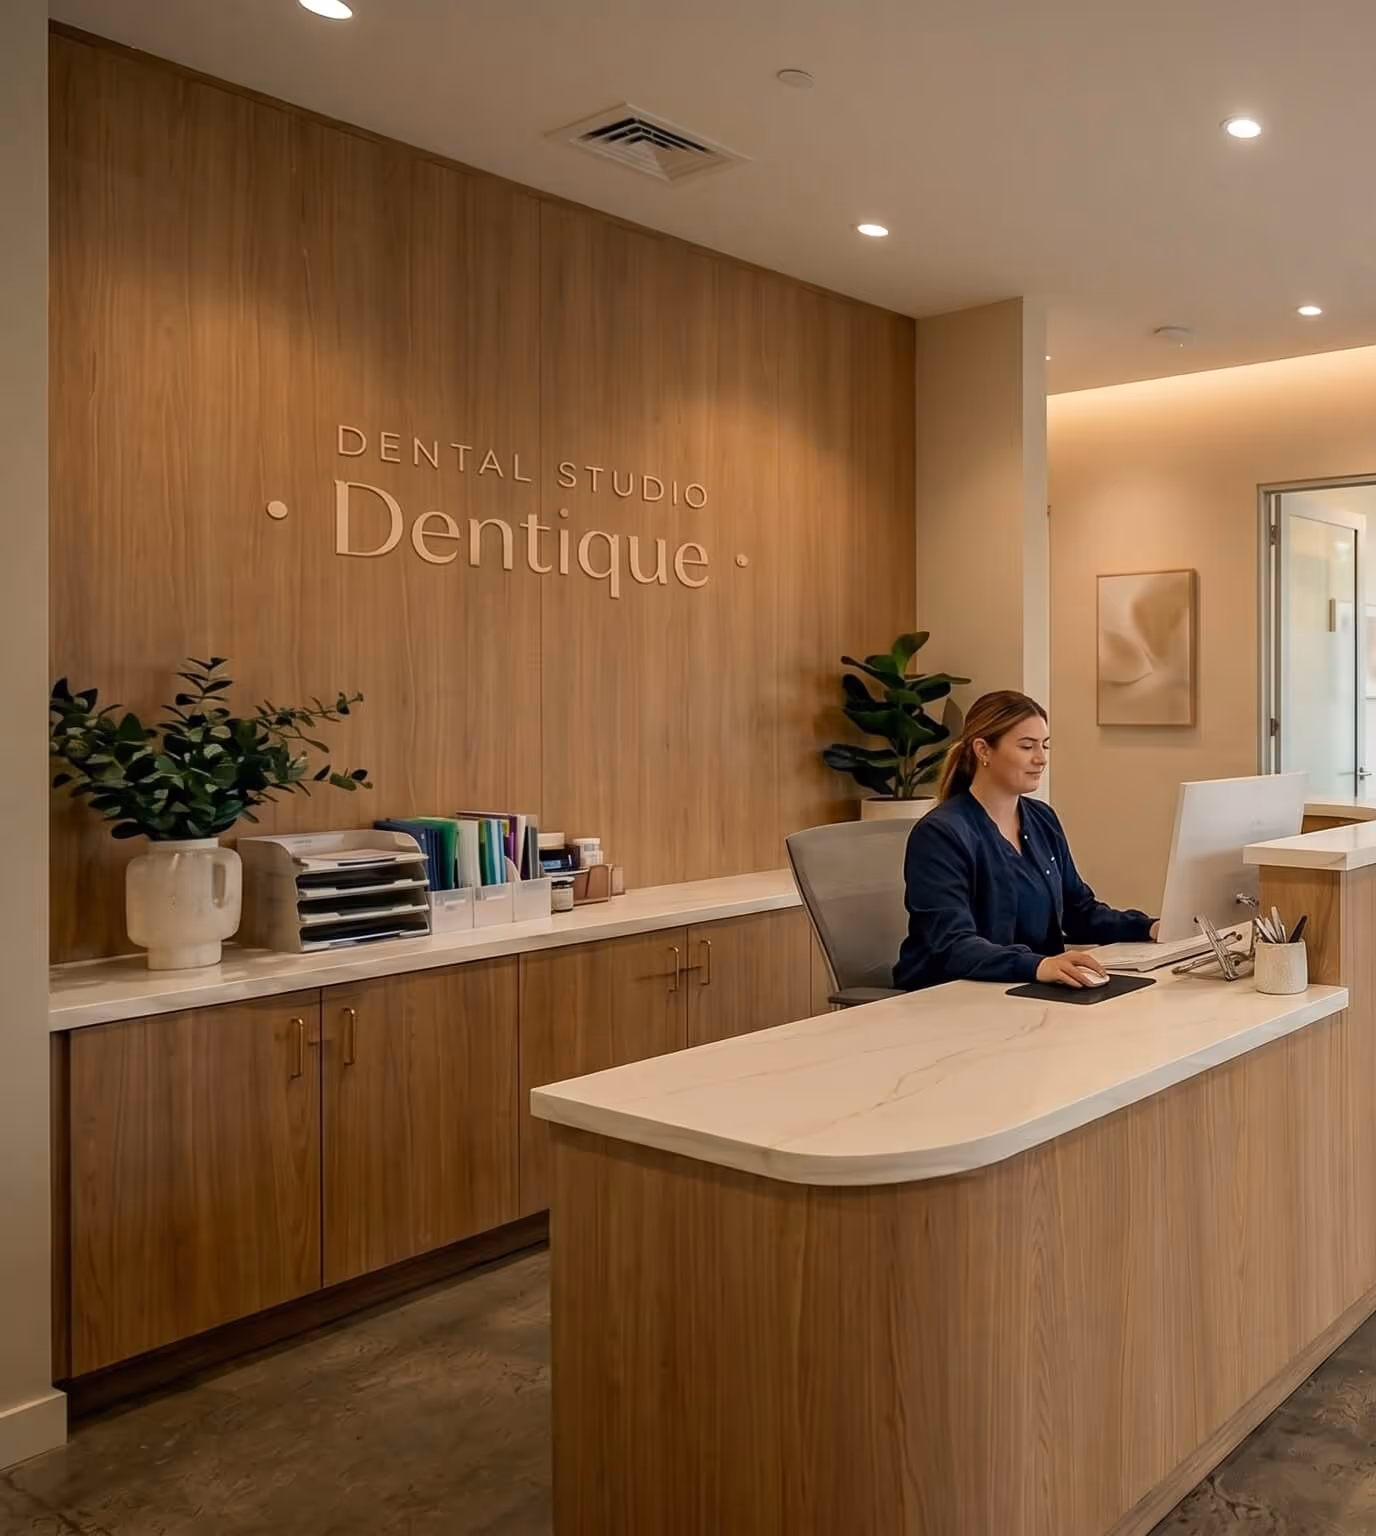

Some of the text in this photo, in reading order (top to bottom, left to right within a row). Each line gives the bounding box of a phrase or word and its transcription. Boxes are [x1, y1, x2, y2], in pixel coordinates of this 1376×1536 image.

[337, 424, 709, 509] DENTAL STUDIO
[334, 480, 710, 598] Dentique
